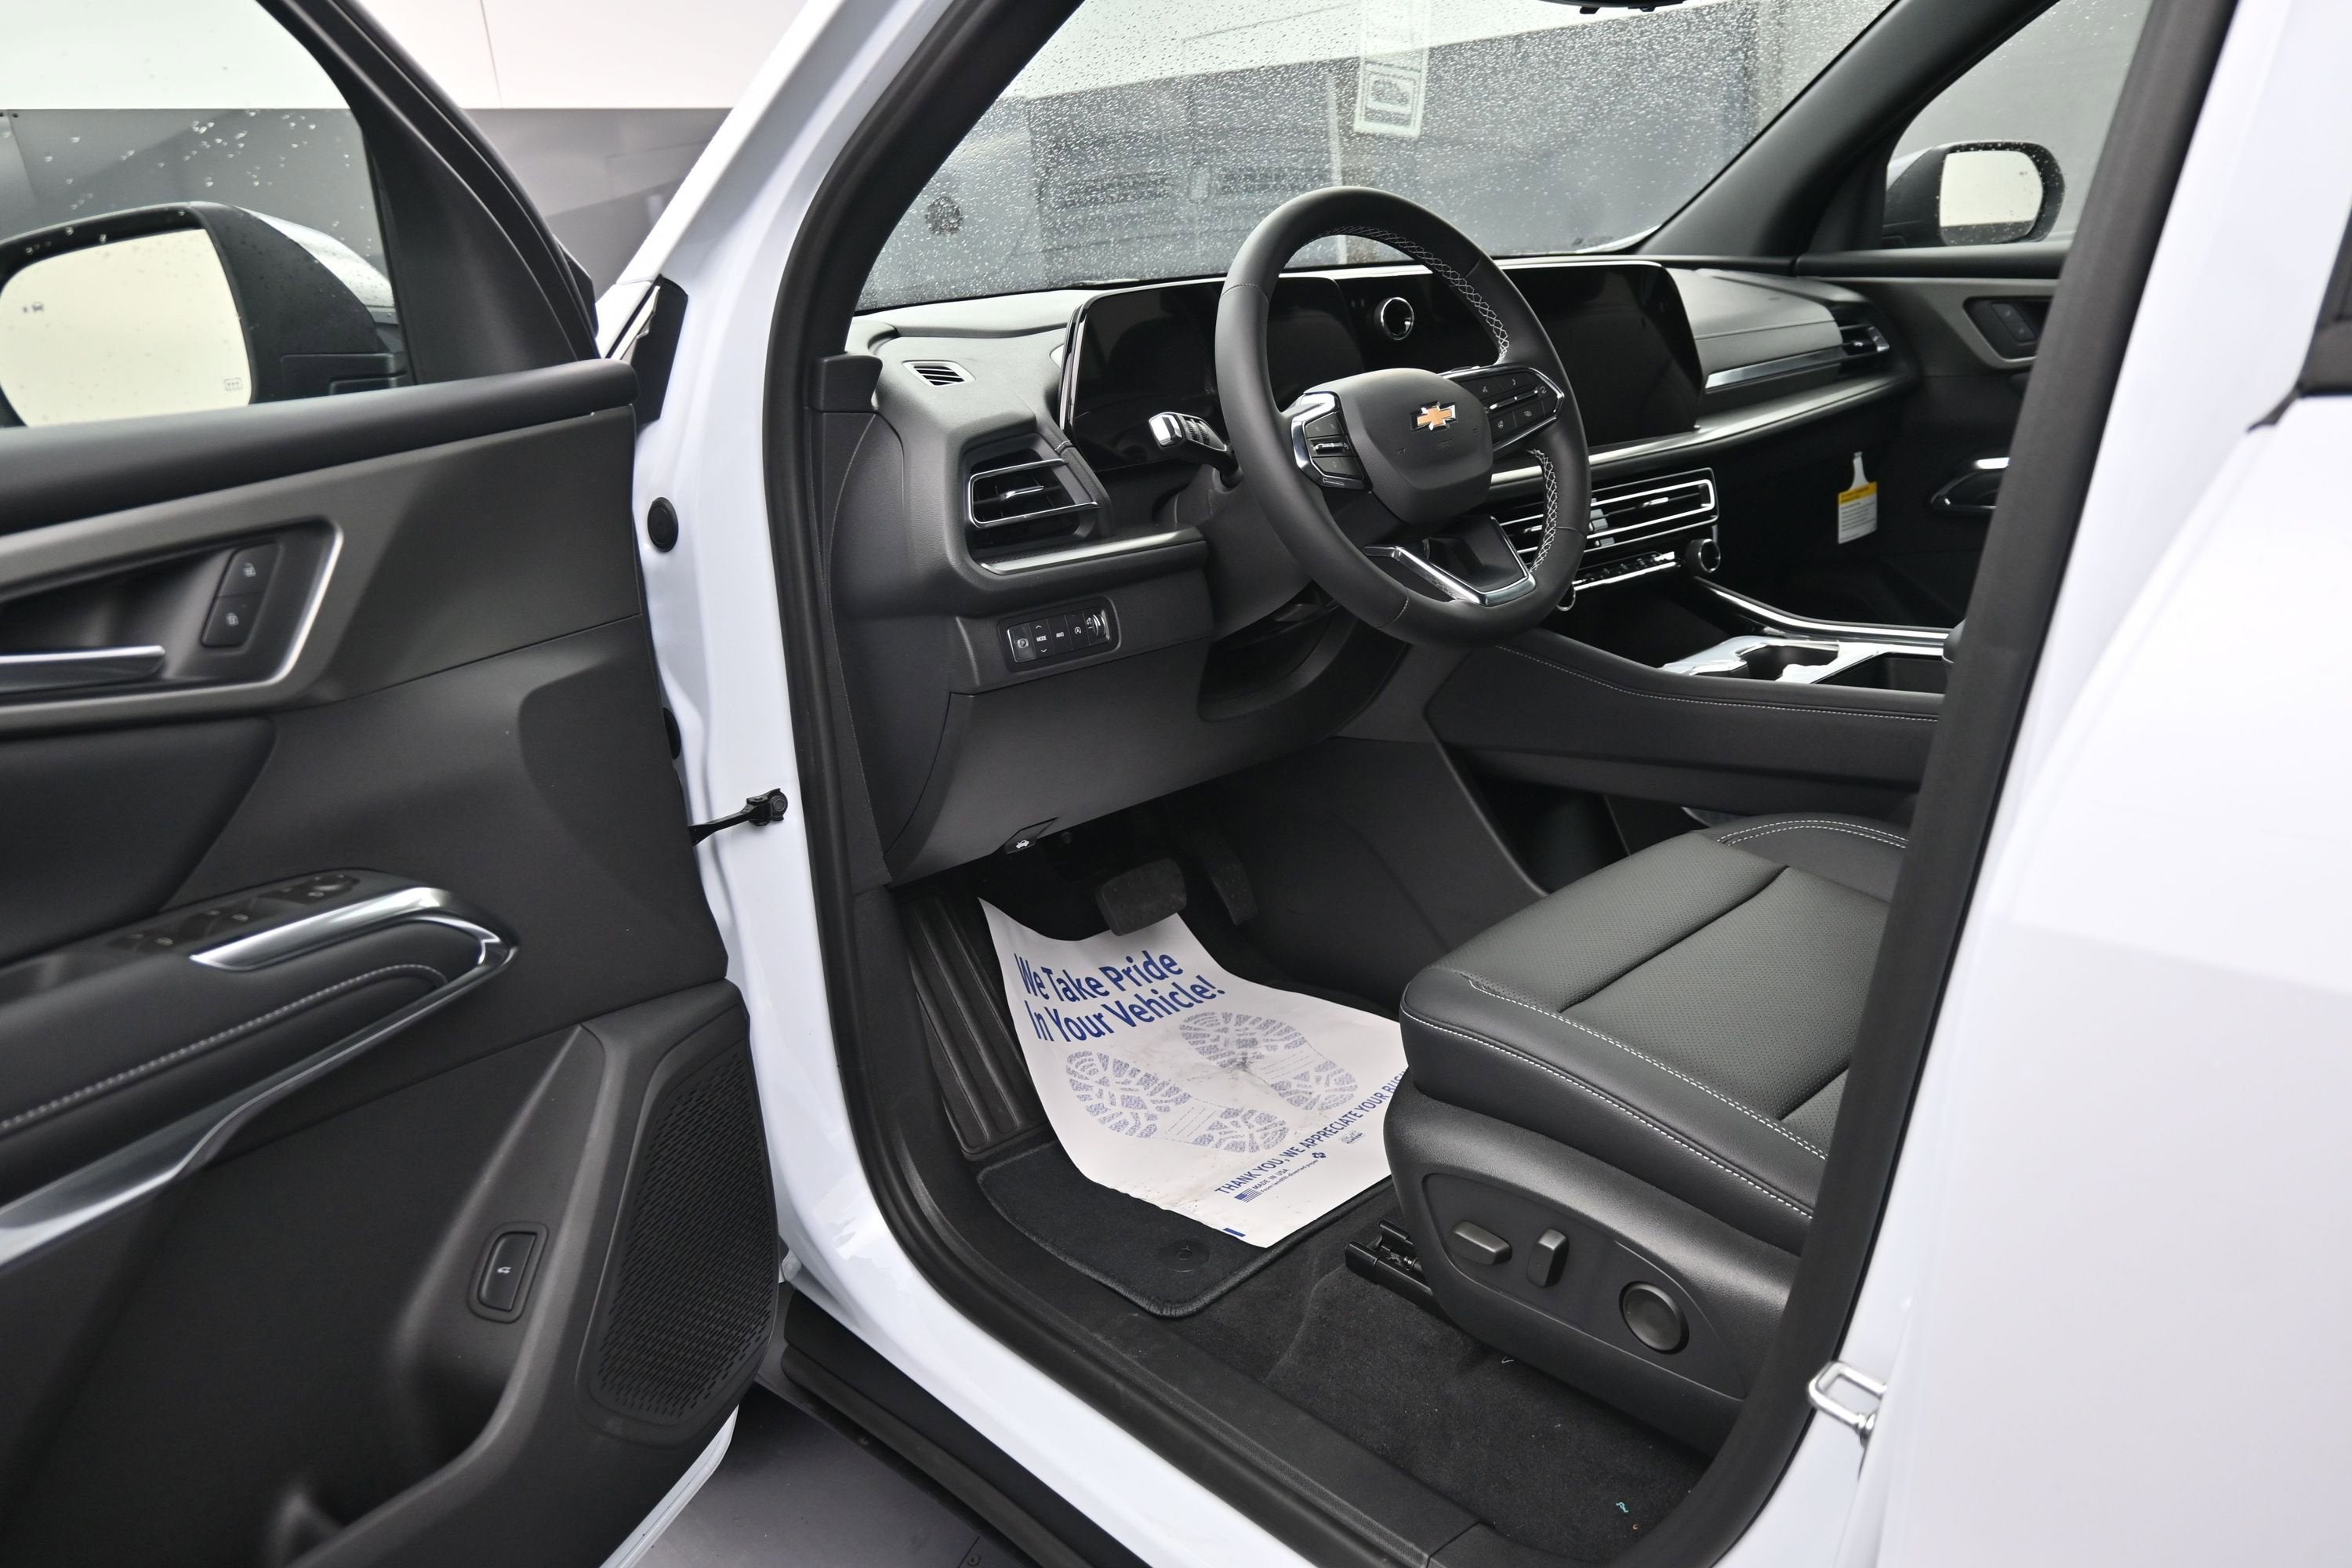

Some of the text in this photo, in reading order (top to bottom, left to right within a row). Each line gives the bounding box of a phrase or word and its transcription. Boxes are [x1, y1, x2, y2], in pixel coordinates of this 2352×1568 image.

[1014, 949, 1184, 1003] We Take Pride
[1024, 974, 1226, 1043] In Your Vehicle!
[1214, 1171, 1261, 1194] THANK
[1279, 1146, 1306, 1159] WE
[1299, 1110, 1364, 1149] APPRECIATE
[1354, 1091, 1391, 1113] YOUR
[1252, 1178, 1272, 1190] MADE
[1275, 1168, 1290, 1177] USA
